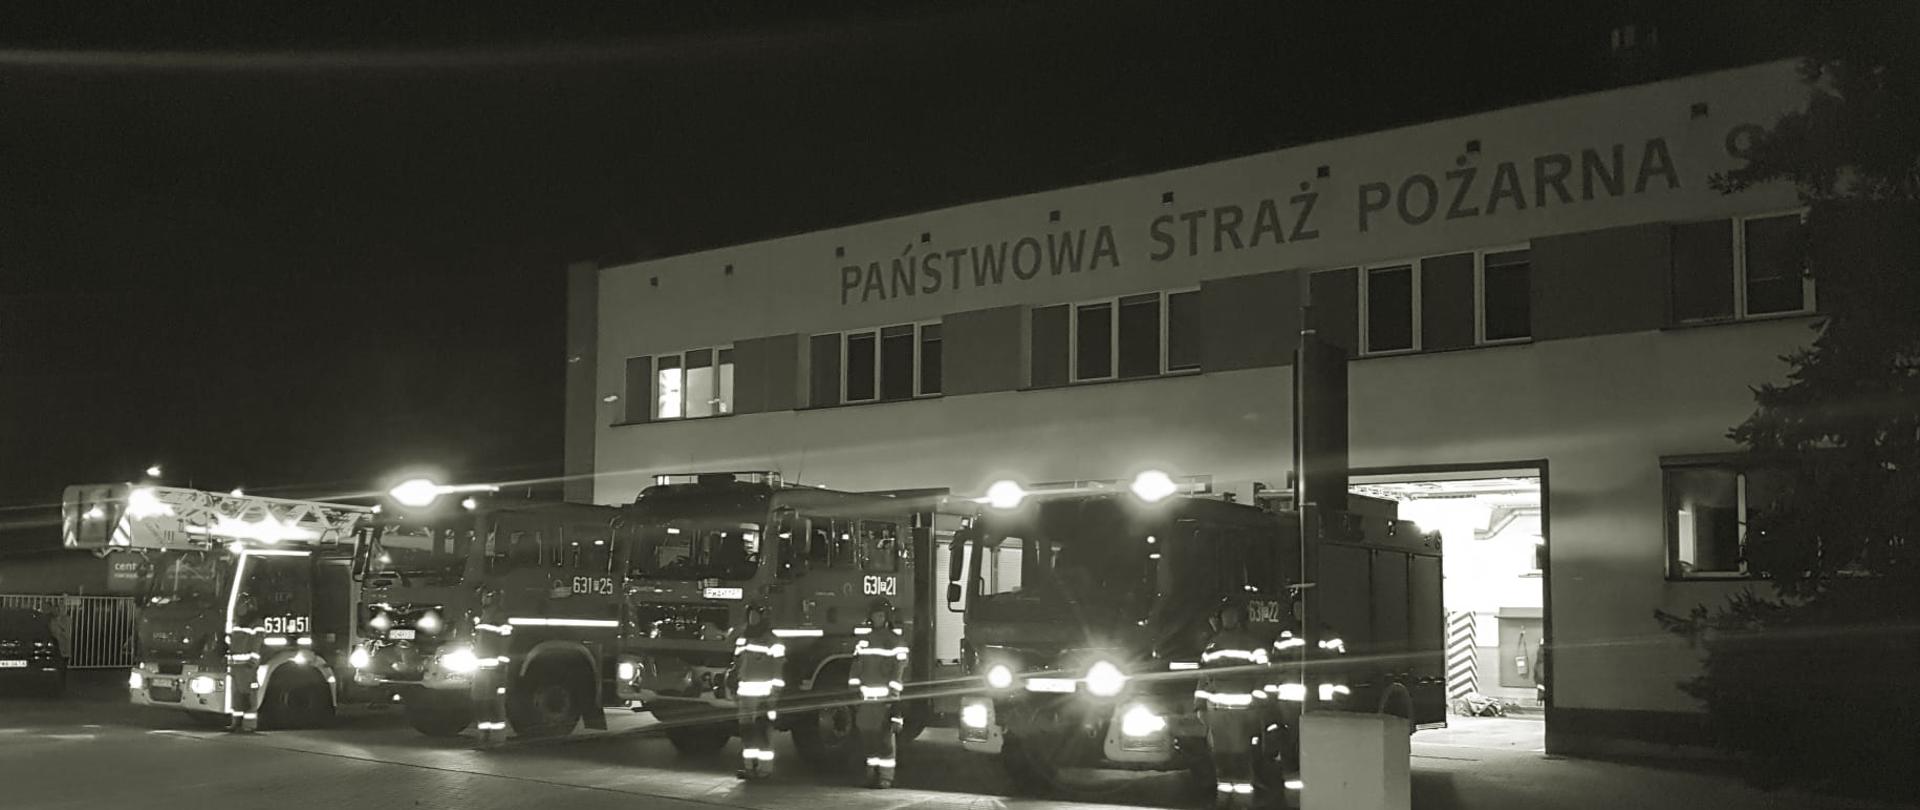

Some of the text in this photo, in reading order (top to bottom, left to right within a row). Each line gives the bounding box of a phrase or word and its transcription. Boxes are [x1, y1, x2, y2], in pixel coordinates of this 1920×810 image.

[841, 225, 1120, 305] PAŃSTWOWA
[1150, 181, 1319, 262] STRAŻ
[1358, 137, 1681, 233] POŻARNA
